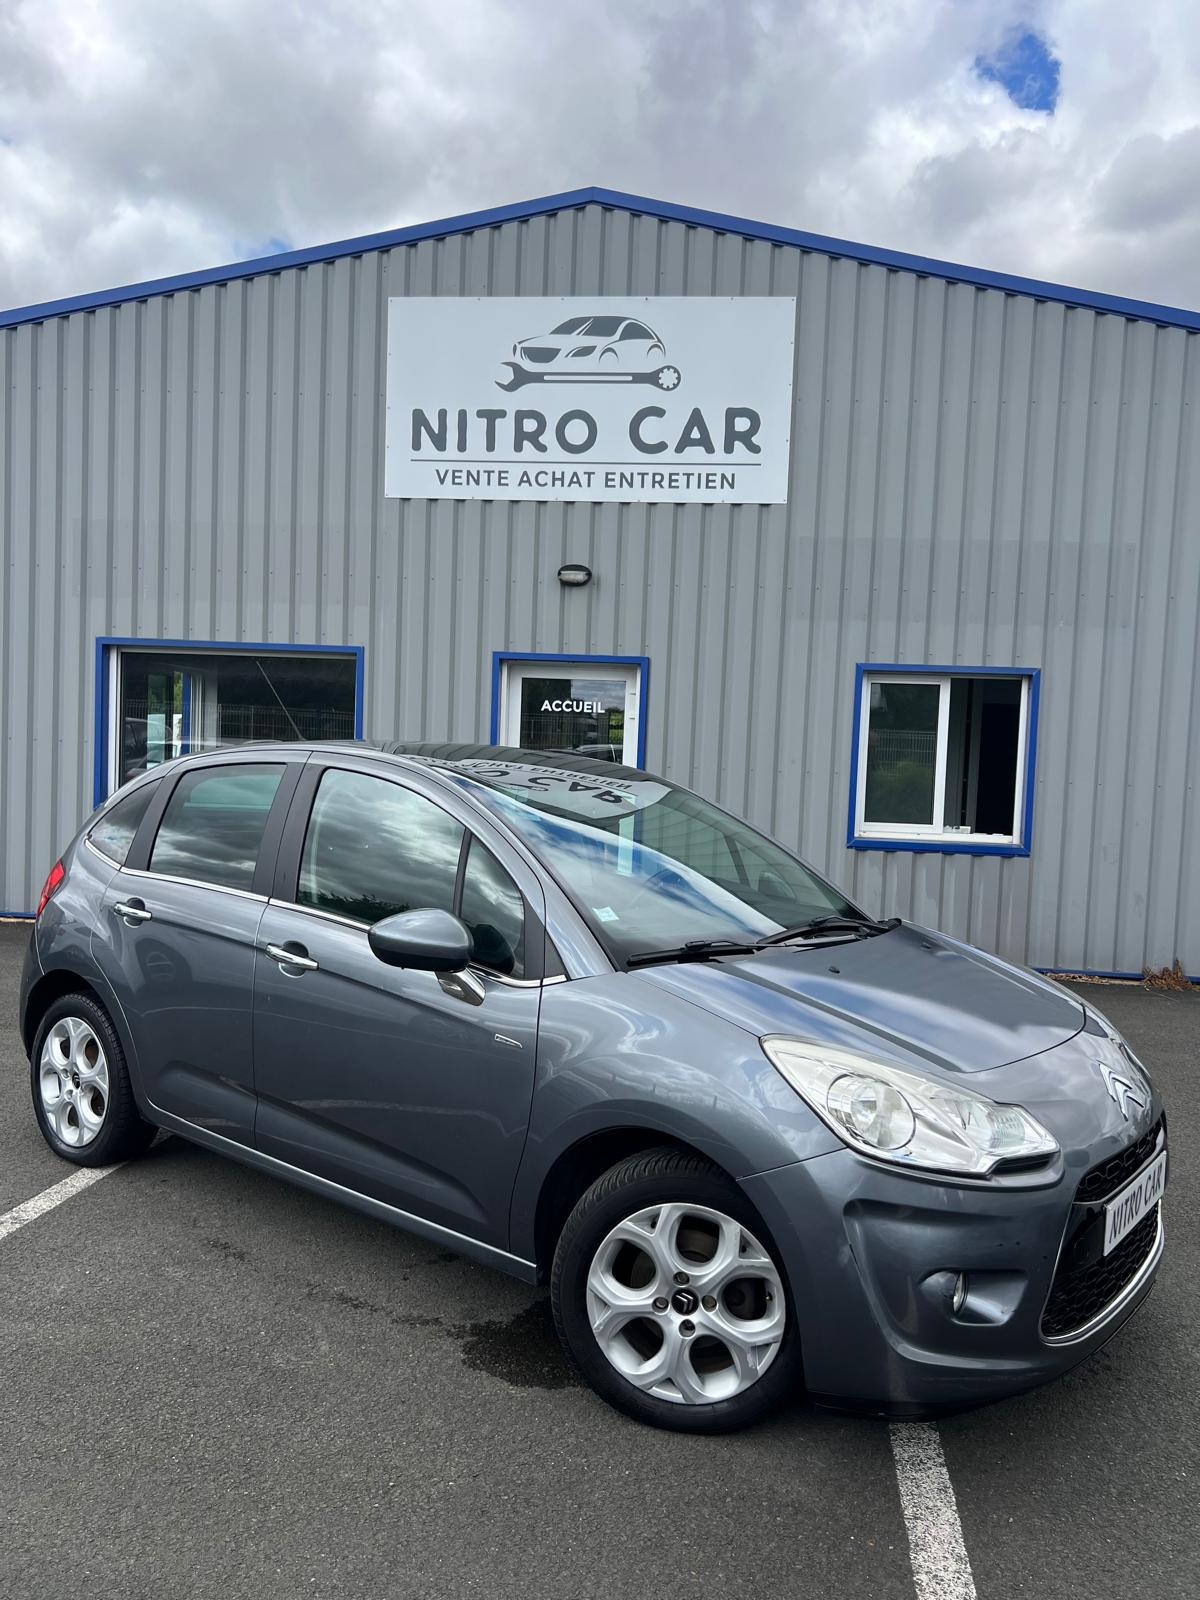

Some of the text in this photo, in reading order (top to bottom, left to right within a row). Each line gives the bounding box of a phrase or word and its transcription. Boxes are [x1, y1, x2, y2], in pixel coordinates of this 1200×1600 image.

[411, 405, 762, 455] NITRO CAR
[436, 468, 736, 490] VENTE ACHAT ENTRETIEN
[540, 700, 606, 714] ACCUEIL
[1109, 1184, 1142, 1244] NITRO
